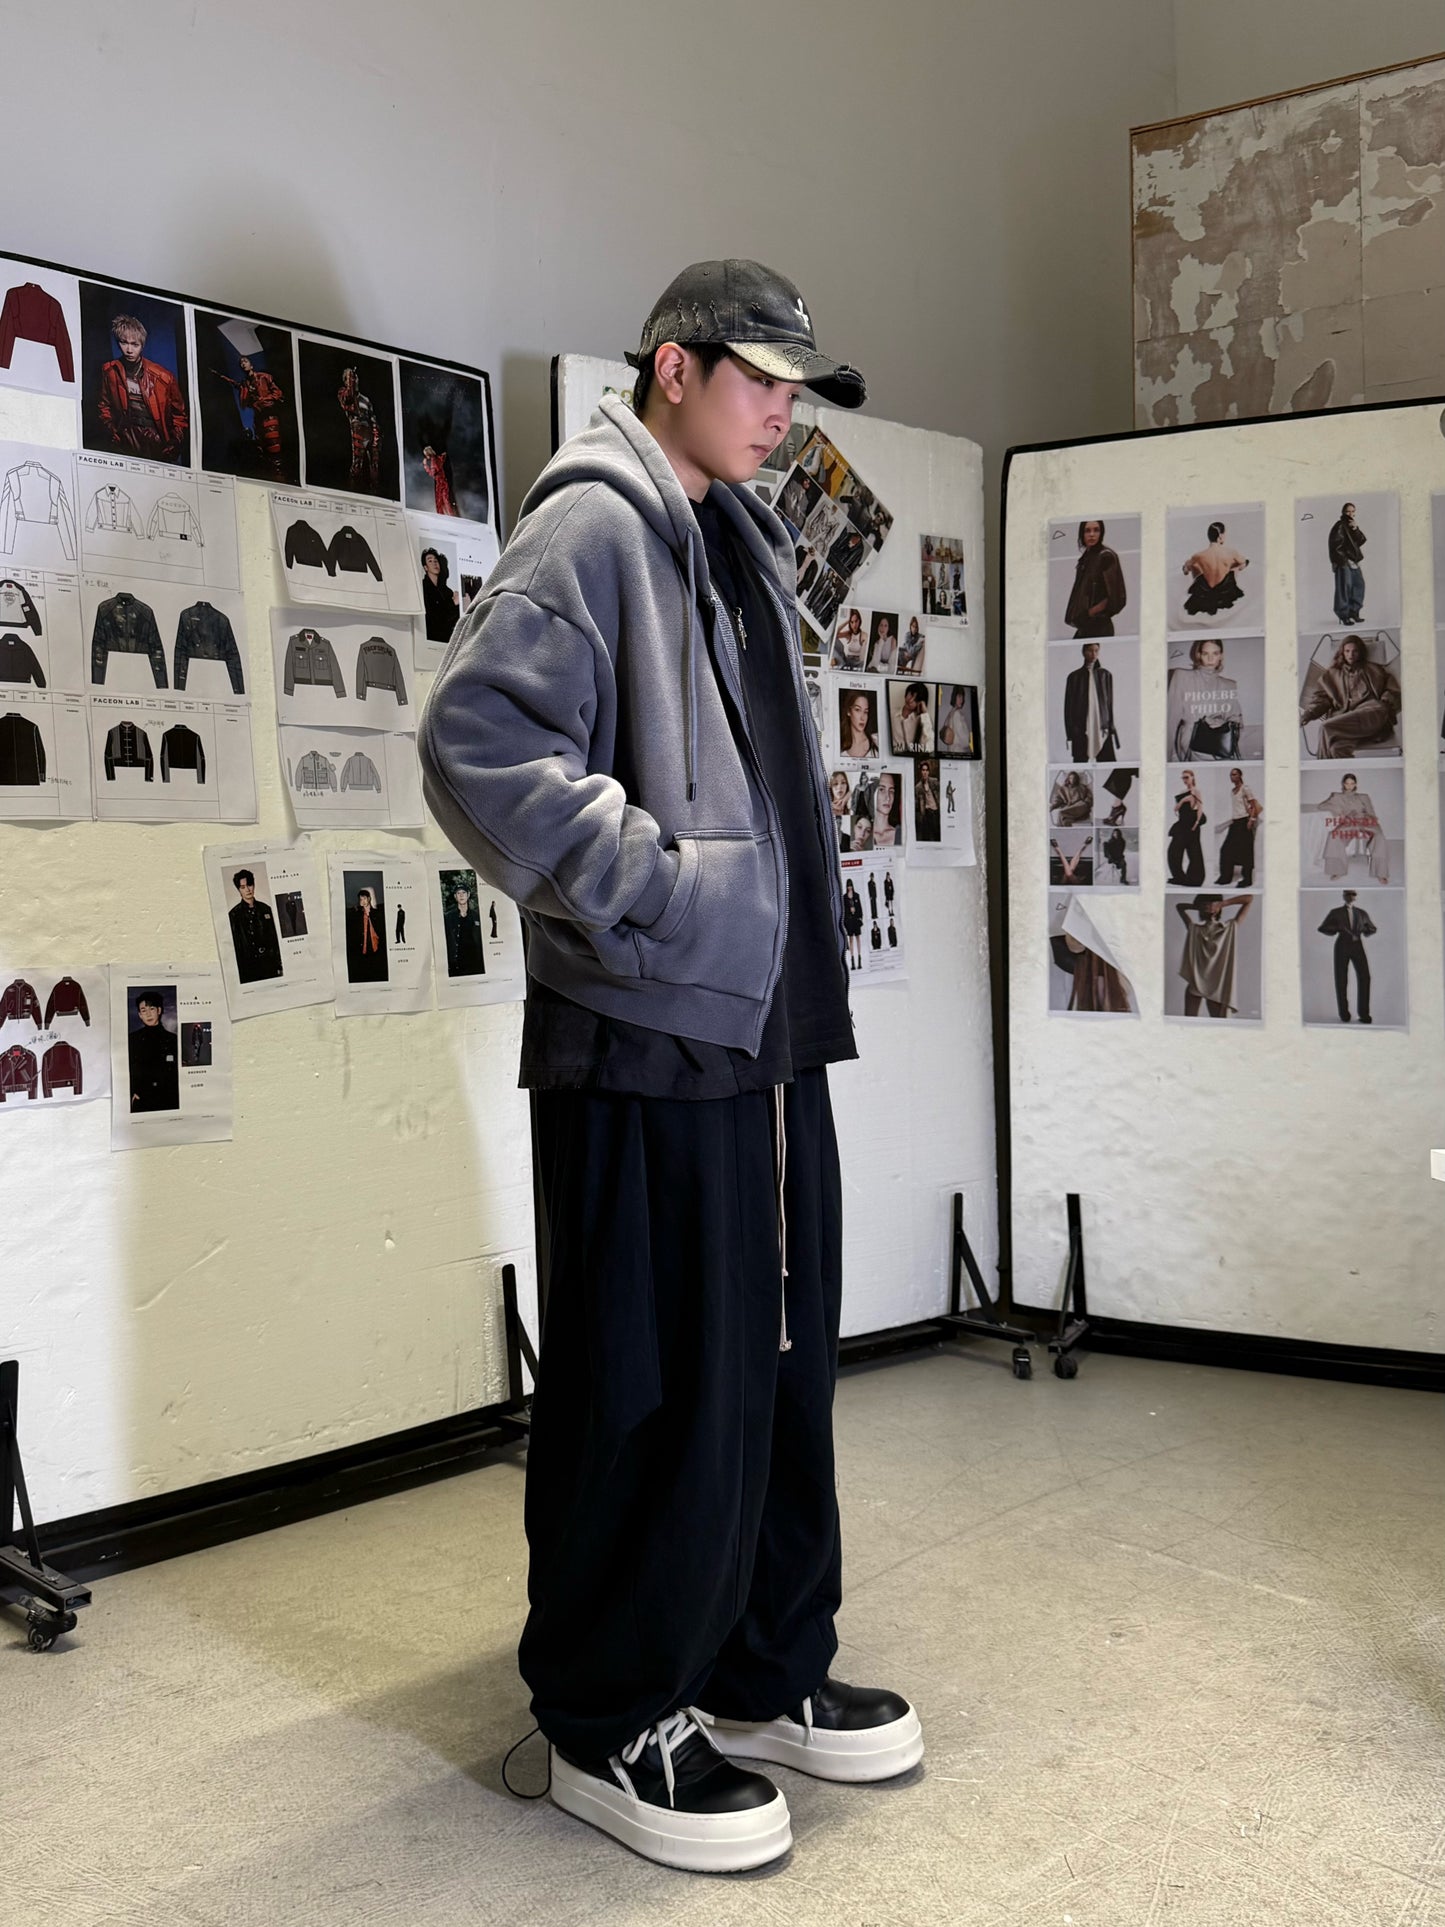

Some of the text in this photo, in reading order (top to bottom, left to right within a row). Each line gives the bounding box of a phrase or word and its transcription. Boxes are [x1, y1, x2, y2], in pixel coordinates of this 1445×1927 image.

[78, 456, 124, 468] FACEON LAB
[274, 495, 298, 504] FACEON
[93, 697, 123, 705] FACEON
[125, 698, 140, 706] LAB
[1184, 690, 1238, 702] PHOEBE
[1190, 703, 1232, 714] PHILO
